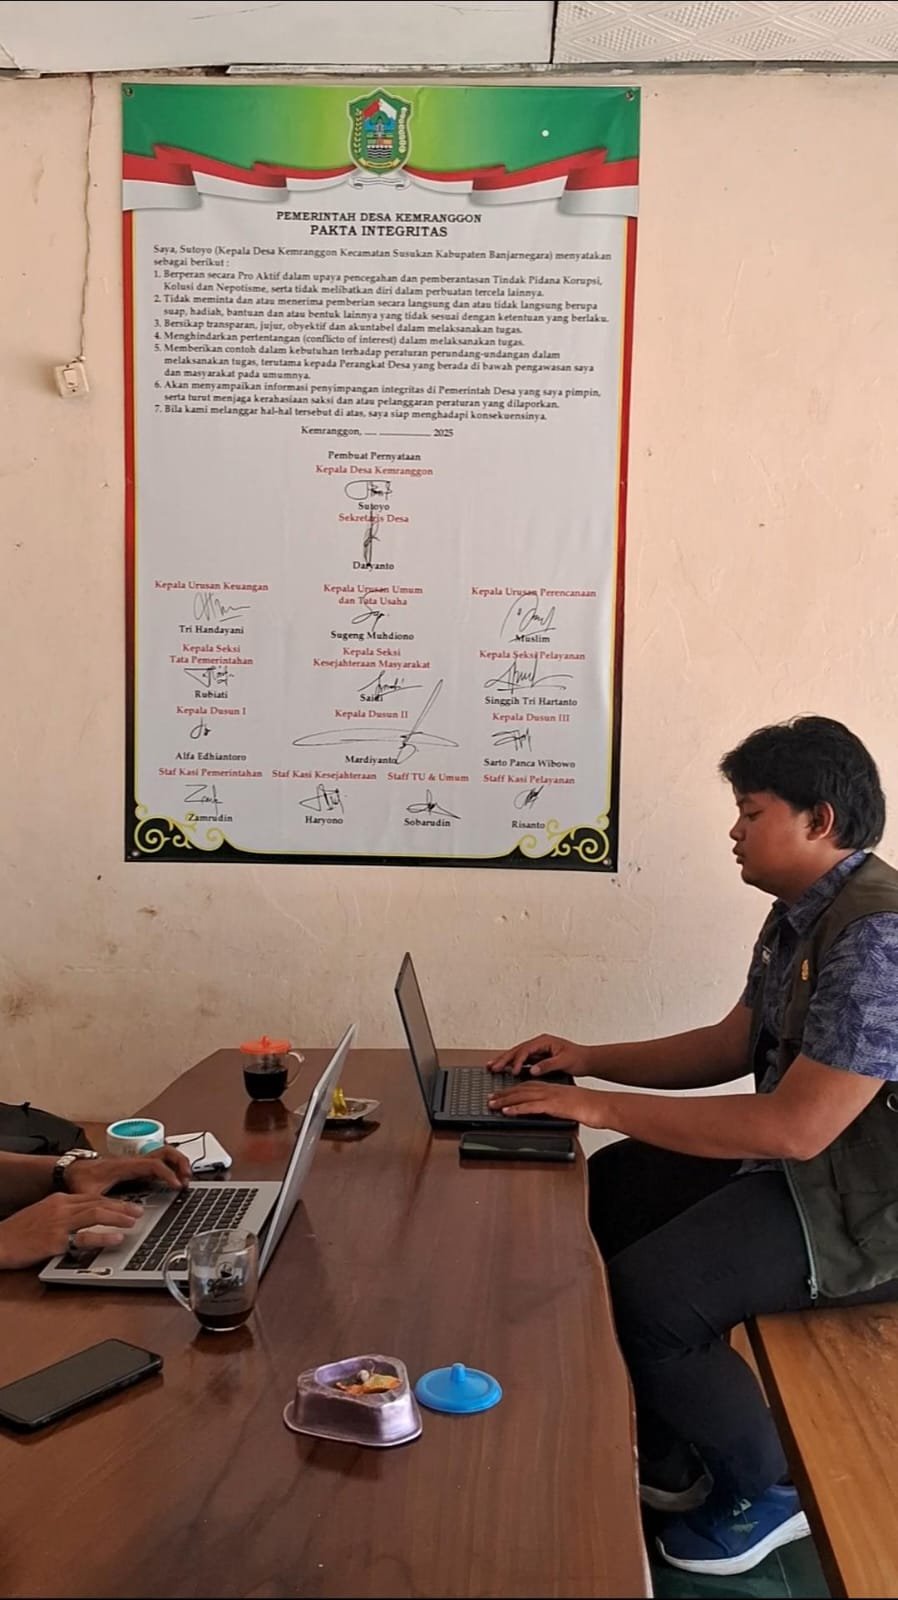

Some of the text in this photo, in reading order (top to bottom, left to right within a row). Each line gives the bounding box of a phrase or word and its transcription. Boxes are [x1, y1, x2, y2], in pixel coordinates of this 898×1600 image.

[276, 211, 481, 223] PEMERINTAH DESA KEMRANGGON
[310, 225, 448, 237] PAKTA INTEGRITAS
[154, 245, 612, 262] Saya, Sutoyo (Kepala Desa Kemranggon Kecamatan Susukan Kabupaten Banjarnegara) menyatakan
[154, 258, 187, 269] sebagai
[190, 258, 224, 267] berikut
[163, 269, 205, 281] Berperan
[237, 271, 253, 279] Pro
[256, 271, 280, 280] Aktif
[282, 271, 310, 280] dalam
[312, 274, 341, 283] upaya
[343, 272, 398, 284] pencegahan
[400, 273, 418, 282] dan
[419, 274, 490, 285] pemberantasan
[493, 275, 525, 284] Tindak
[528, 275, 560, 284] Pidana
[562, 276, 602, 287] Korupsi,
[164, 282, 544, 299] Kolusi dan Nepotisme, serta tidak melibatkan diri dalam perbuatan tercela lainnya.
[163, 319, 204, 331] Bersikap
[206, 320, 257, 332] transparan,
[259, 321, 284, 332] jujur,
[287, 321, 326, 333] obyektif
[328, 322, 346, 331] dan
[348, 322, 394, 331] akuntabel
[396, 323, 425, 332] dalam
[427, 323, 493, 333] melaksanakan
[495, 324, 522, 336] tugas.
[163, 331, 237, 343] Menghindarkan
[239, 332, 300, 344] pertentangan
[346, 334, 356, 343] of
[358, 334, 396, 345] interest)
[398, 335, 427, 344] dalam
[429, 335, 495, 345] melaksanakan
[497, 336, 524, 348] tugas.
[164, 368, 310, 381] dan masyarakat pada umumnya.
[164, 405, 182, 414] Bila
[184, 405, 208, 414] kami
[210, 406, 258, 417] melanggar
[260, 407, 292, 416] hal-hal
[294, 407, 332, 416] tersebut
[333, 408, 343, 416] di
[345, 408, 365, 418] atas,
[368, 411, 388, 420] saya
[390, 409, 409, 420] siap
[411, 409, 468, 421] menghadapi
[301, 426, 454, 438] Kemranggon, 2025
[328, 451, 421, 463] Pembuat Pernyataan
[316, 465, 434, 477] Kepala Desa Kemranggon
[358, 502, 390, 513] Sutoyo
[338, 513, 409, 523] Sekretaris Desa
[352, 561, 394, 572] Daryanto
[154, 580, 269, 593] Kepala Urusan Keuangan
[324, 584, 423, 596] Kepala Urusan Umum
[472, 587, 596, 598] Kepala Urusan Perencanaan
[338, 596, 355, 605] dan
[379, 597, 407, 606] Usaha
[178, 625, 244, 636] Tri Handayani
[330, 631, 414, 642] Sugeng Muhdiono
[515, 634, 550, 643] Muslim
[182, 644, 240, 655] Kepala Seksi
[342, 647, 401, 658] Kepala Seksi
[170, 655, 253, 665] Tata Pemerintahan
[479, 650, 585, 662] Kepala Seksi Pelayanan
[312, 659, 430, 671] Kesejahteraan Masyarakat
[194, 690, 228, 699] Rubiati
[484, 696, 578, 707] Singgih Tri Hartanto
[176, 706, 246, 717] Kepala Dusun I
[335, 710, 408, 721] Kepala Dusun II
[492, 713, 570, 724] Kepala Dusun III
[175, 752, 246, 761] Alfa Edhiantoro
[345, 755, 398, 766] Mardiyanto
[483, 758, 576, 768] Sarto Panca Wibowo
[158, 767, 263, 777] Staf Kasi Pemerintahan
[272, 770, 376, 782] Staf Kasi Kesejahteraan
[387, 772, 469, 782] Staff TU & Umum
[483, 774, 575, 787] Staff Kasi Pelayanan
[188, 813, 233, 822] Zamrudin
[304, 816, 344, 827] Haryono
[403, 818, 451, 827] Sobarudin
[511, 821, 545, 830] Risanto
